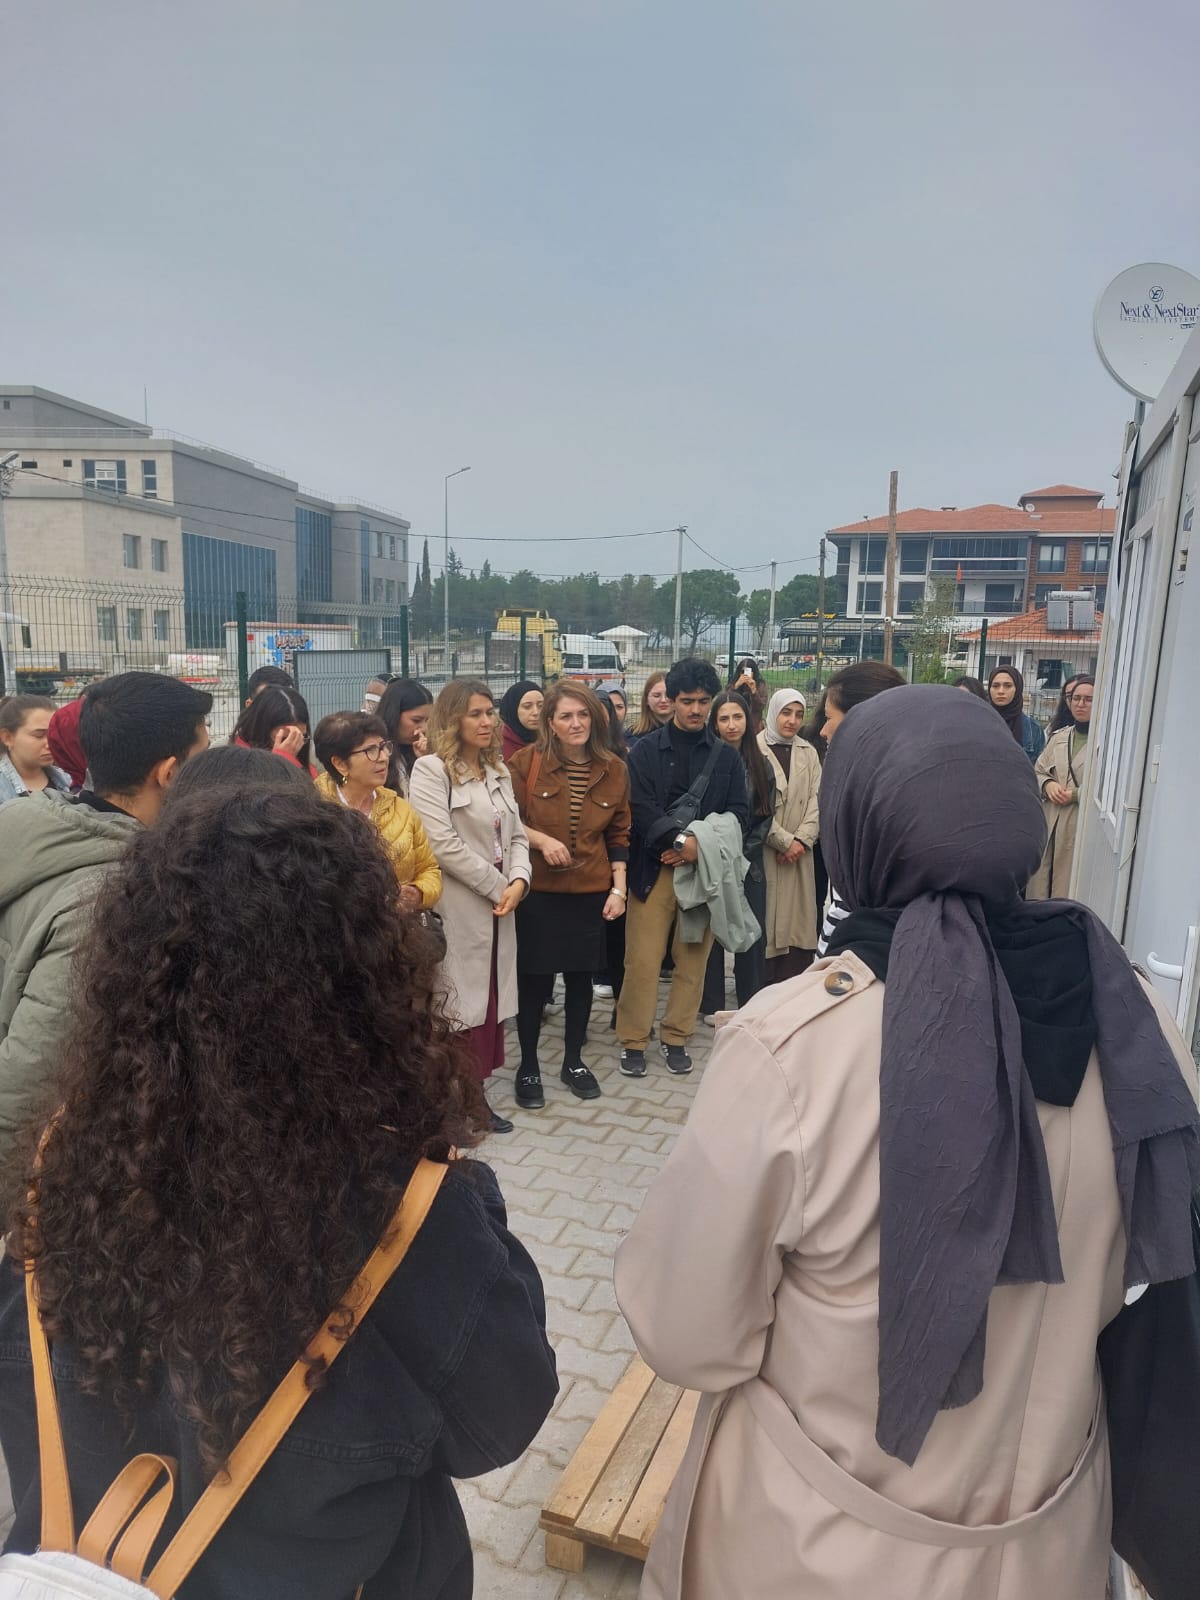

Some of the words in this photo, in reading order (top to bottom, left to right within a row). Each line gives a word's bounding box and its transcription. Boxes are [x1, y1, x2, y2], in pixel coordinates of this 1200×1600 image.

[1120, 301, 1140, 317] Next
[1142, 304, 1151, 318] &
[1154, 303, 1199, 318] NextStar
